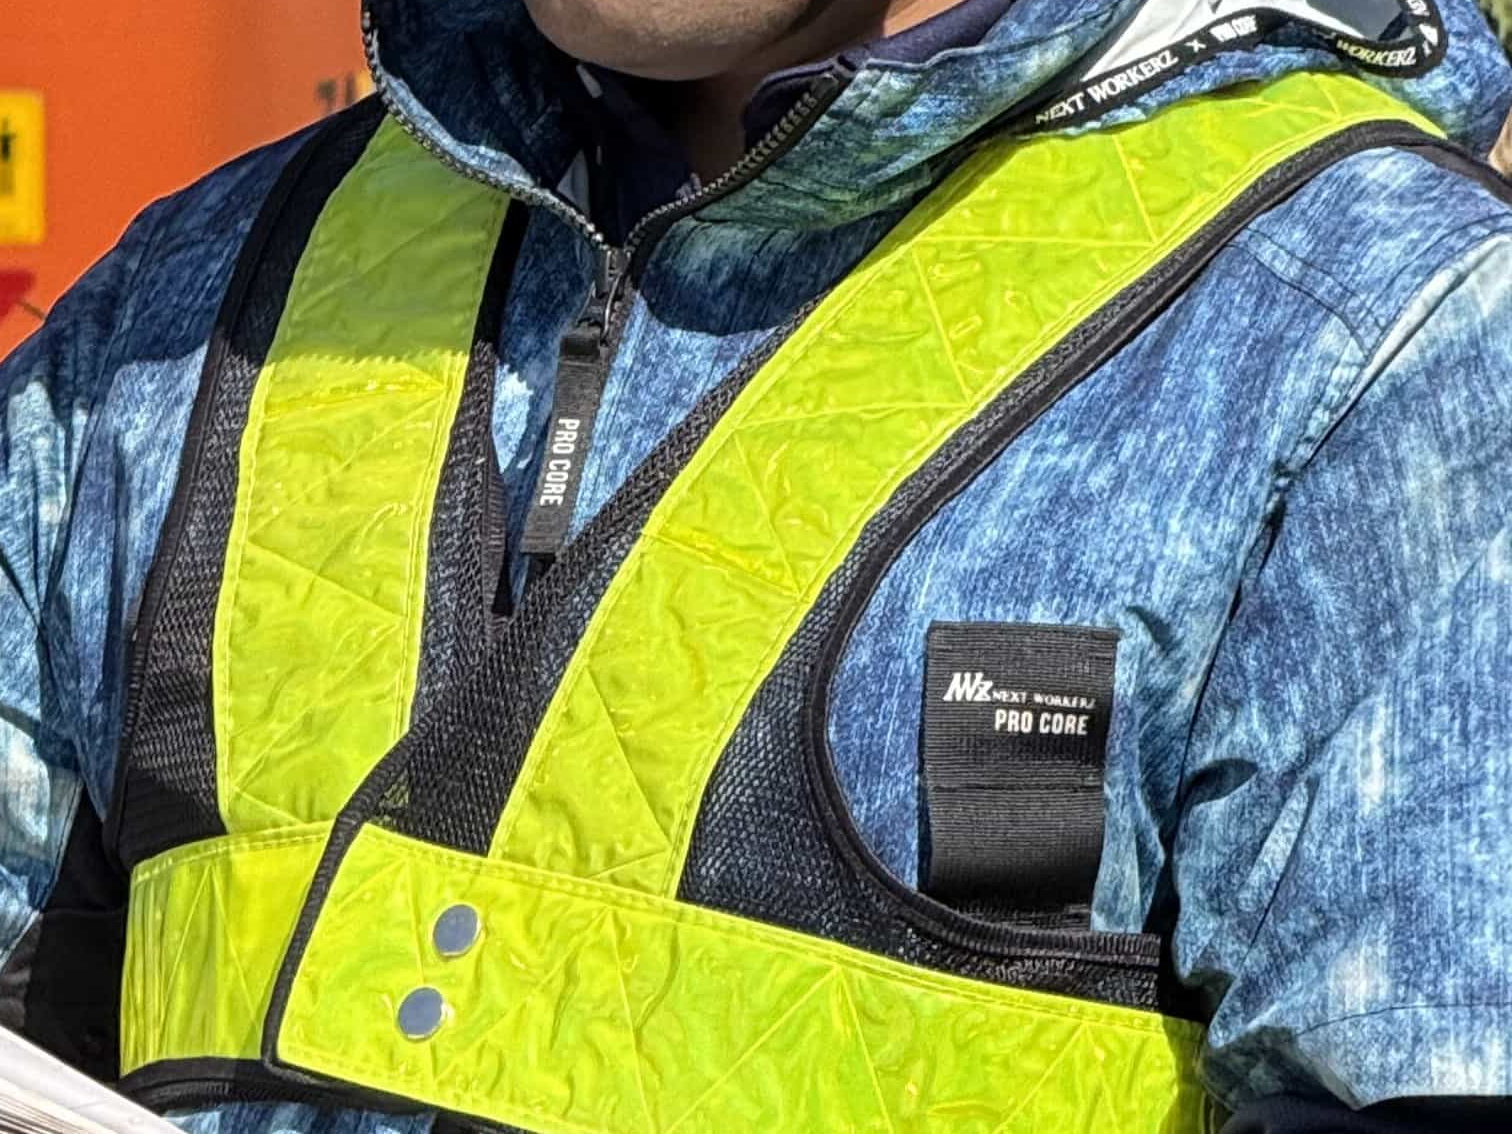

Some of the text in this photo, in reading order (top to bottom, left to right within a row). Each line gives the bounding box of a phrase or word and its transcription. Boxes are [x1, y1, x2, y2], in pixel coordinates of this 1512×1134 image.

[1035, 92, 1086, 125] NEXT
[1087, 50, 1180, 104] WORKERZ
[539, 418, 581, 506] PRO CORE
[993, 690, 1026, 703] NEXT
[995, 709, 1089, 736] PRO CORE
